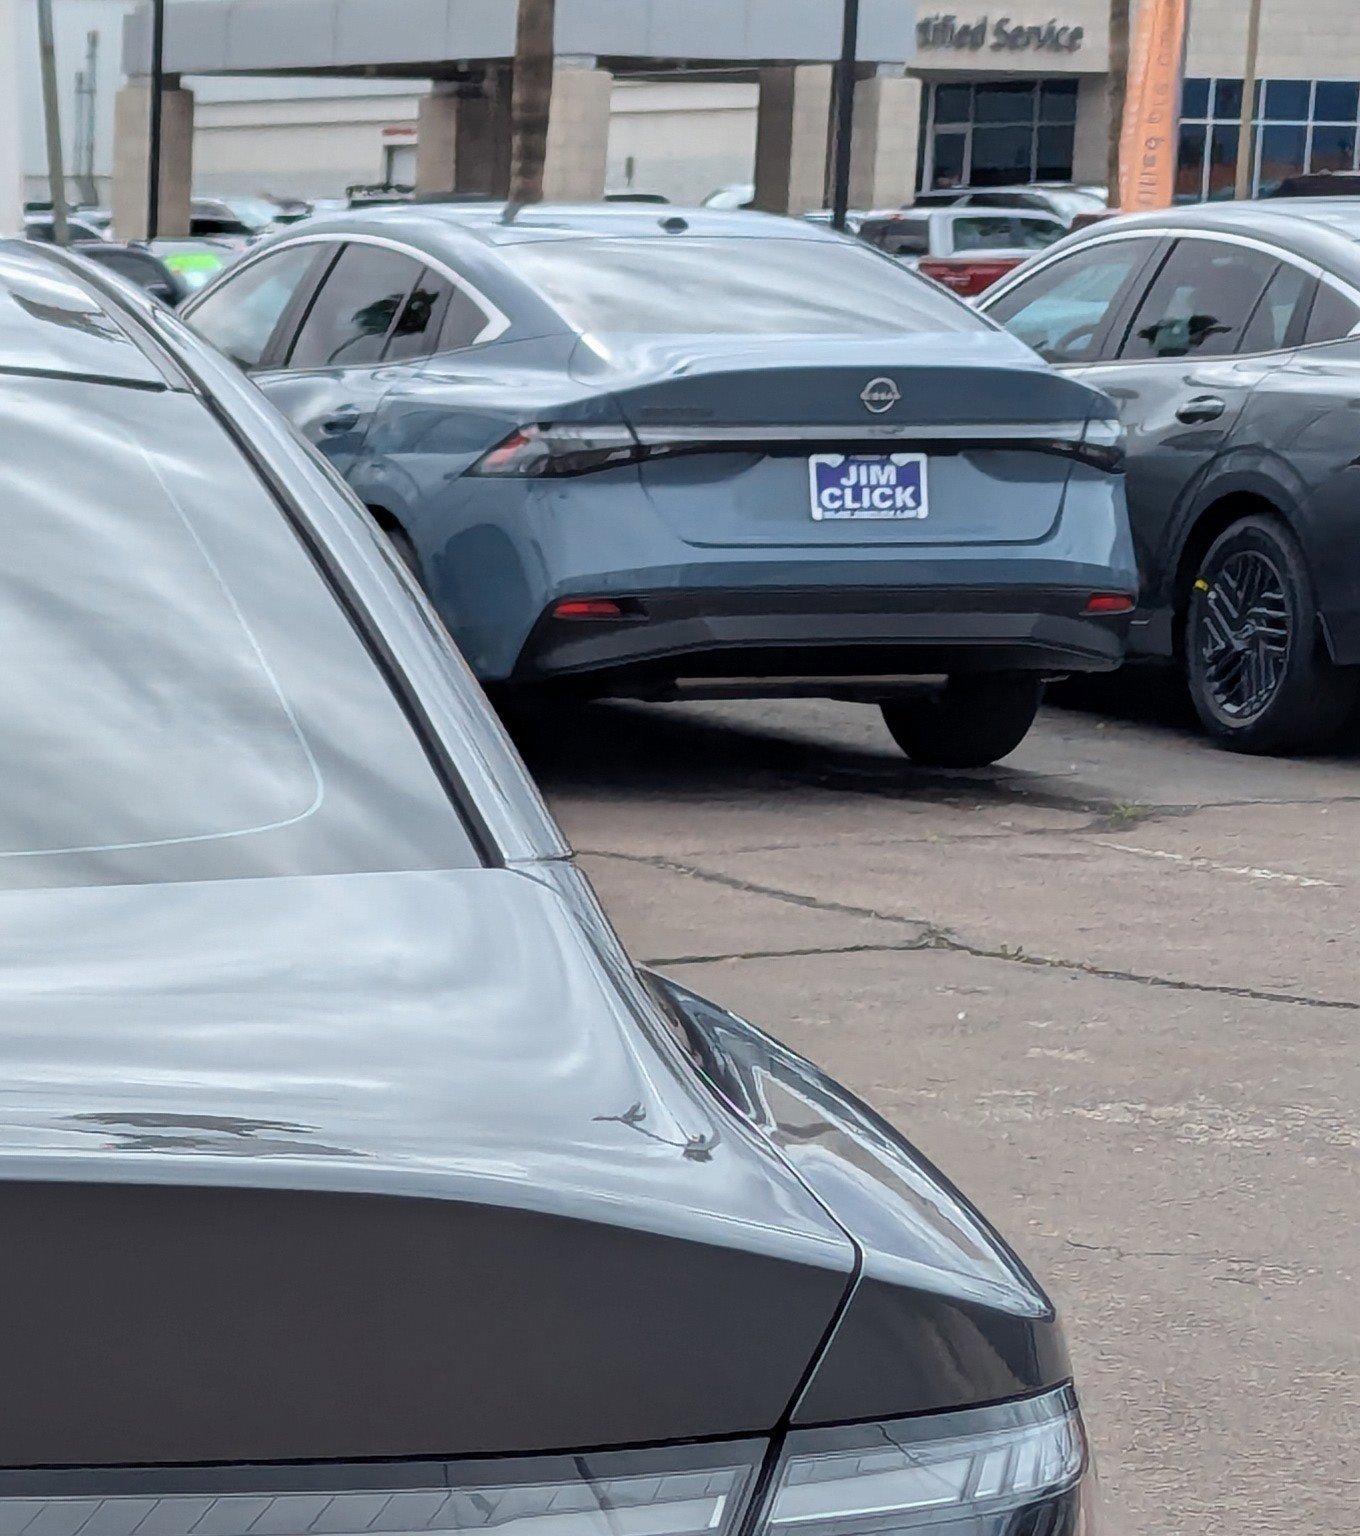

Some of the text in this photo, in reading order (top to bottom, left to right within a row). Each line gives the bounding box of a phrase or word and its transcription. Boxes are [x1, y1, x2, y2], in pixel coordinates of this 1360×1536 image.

[989, 17, 1084, 52] Service
[840, 464, 897, 486] JIM
[820, 487, 916, 509] CLICK
